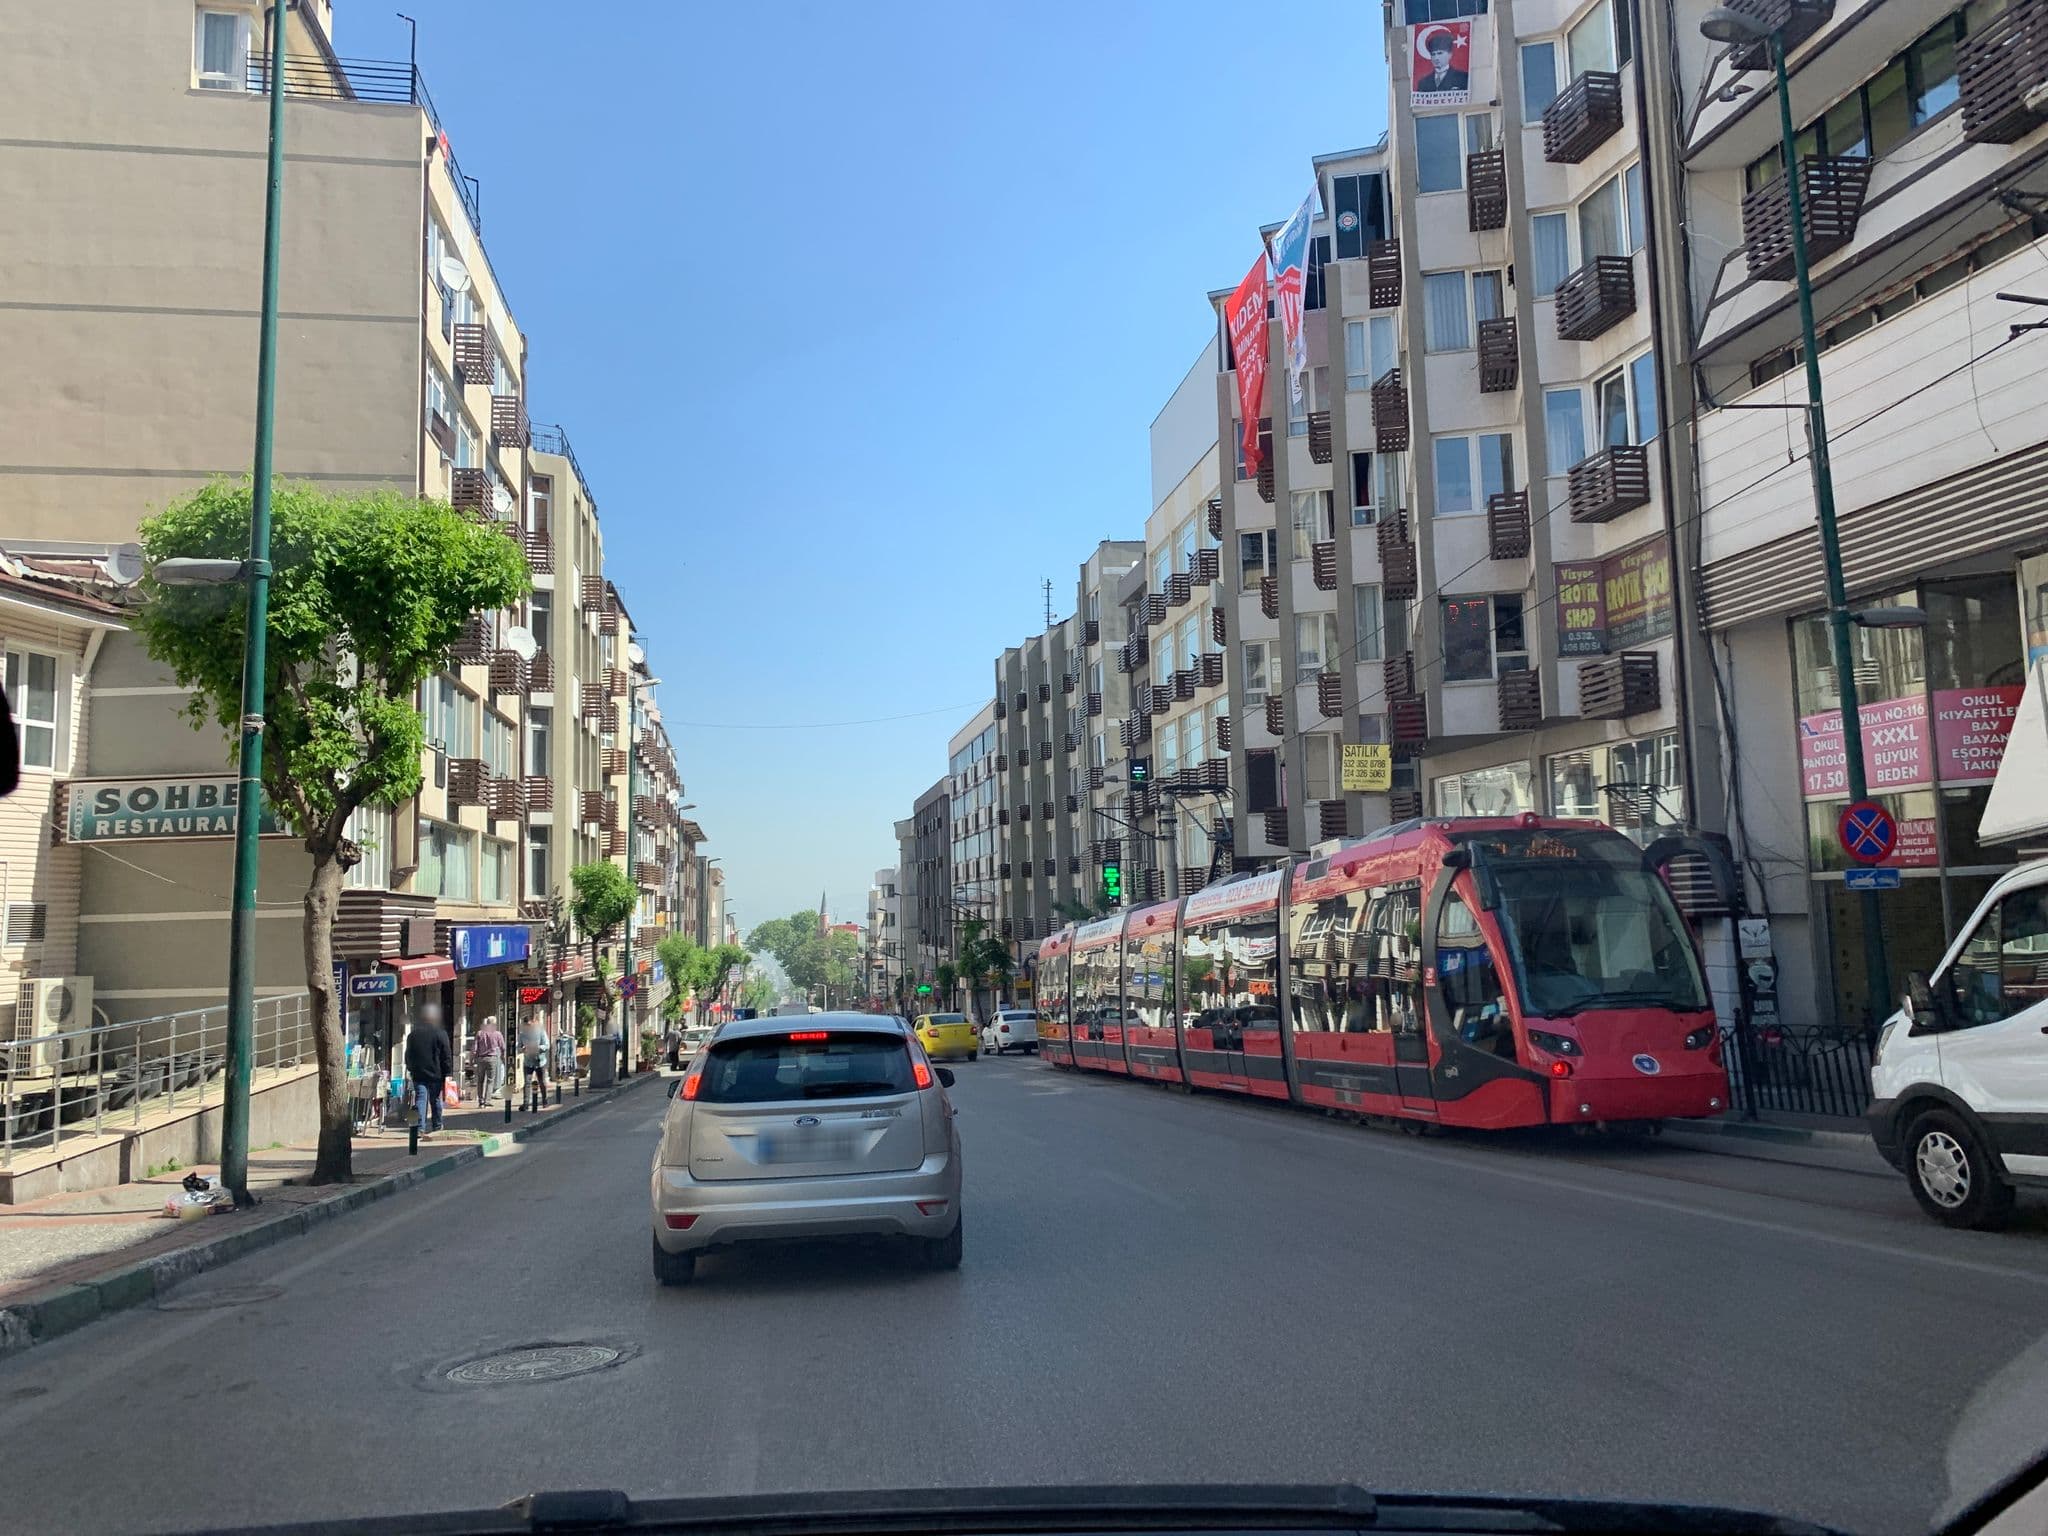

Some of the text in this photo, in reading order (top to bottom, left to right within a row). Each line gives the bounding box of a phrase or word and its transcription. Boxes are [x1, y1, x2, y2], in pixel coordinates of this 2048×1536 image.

[1561, 568, 1595, 581] Vizyon
[1566, 608, 1596, 629] SHOP
[1962, 695, 2005, 706] OKUL
[1885, 703, 1925, 721] NO:116
[1972, 721, 1999, 732] BAY
[1872, 724, 1919, 747] XXXL
[1344, 745, 1379, 757] SATILIK
[1813, 738, 1839, 753] OKUL
[1803, 752, 1847, 770] PANTOLO
[1874, 745, 1918, 766] BÜYÜK
[1877, 764, 1918, 783] BEDEN
[1963, 760, 2001, 771] TAKI
[93, 784, 238, 815] SOHBE
[357, 980, 389, 990] KVK
